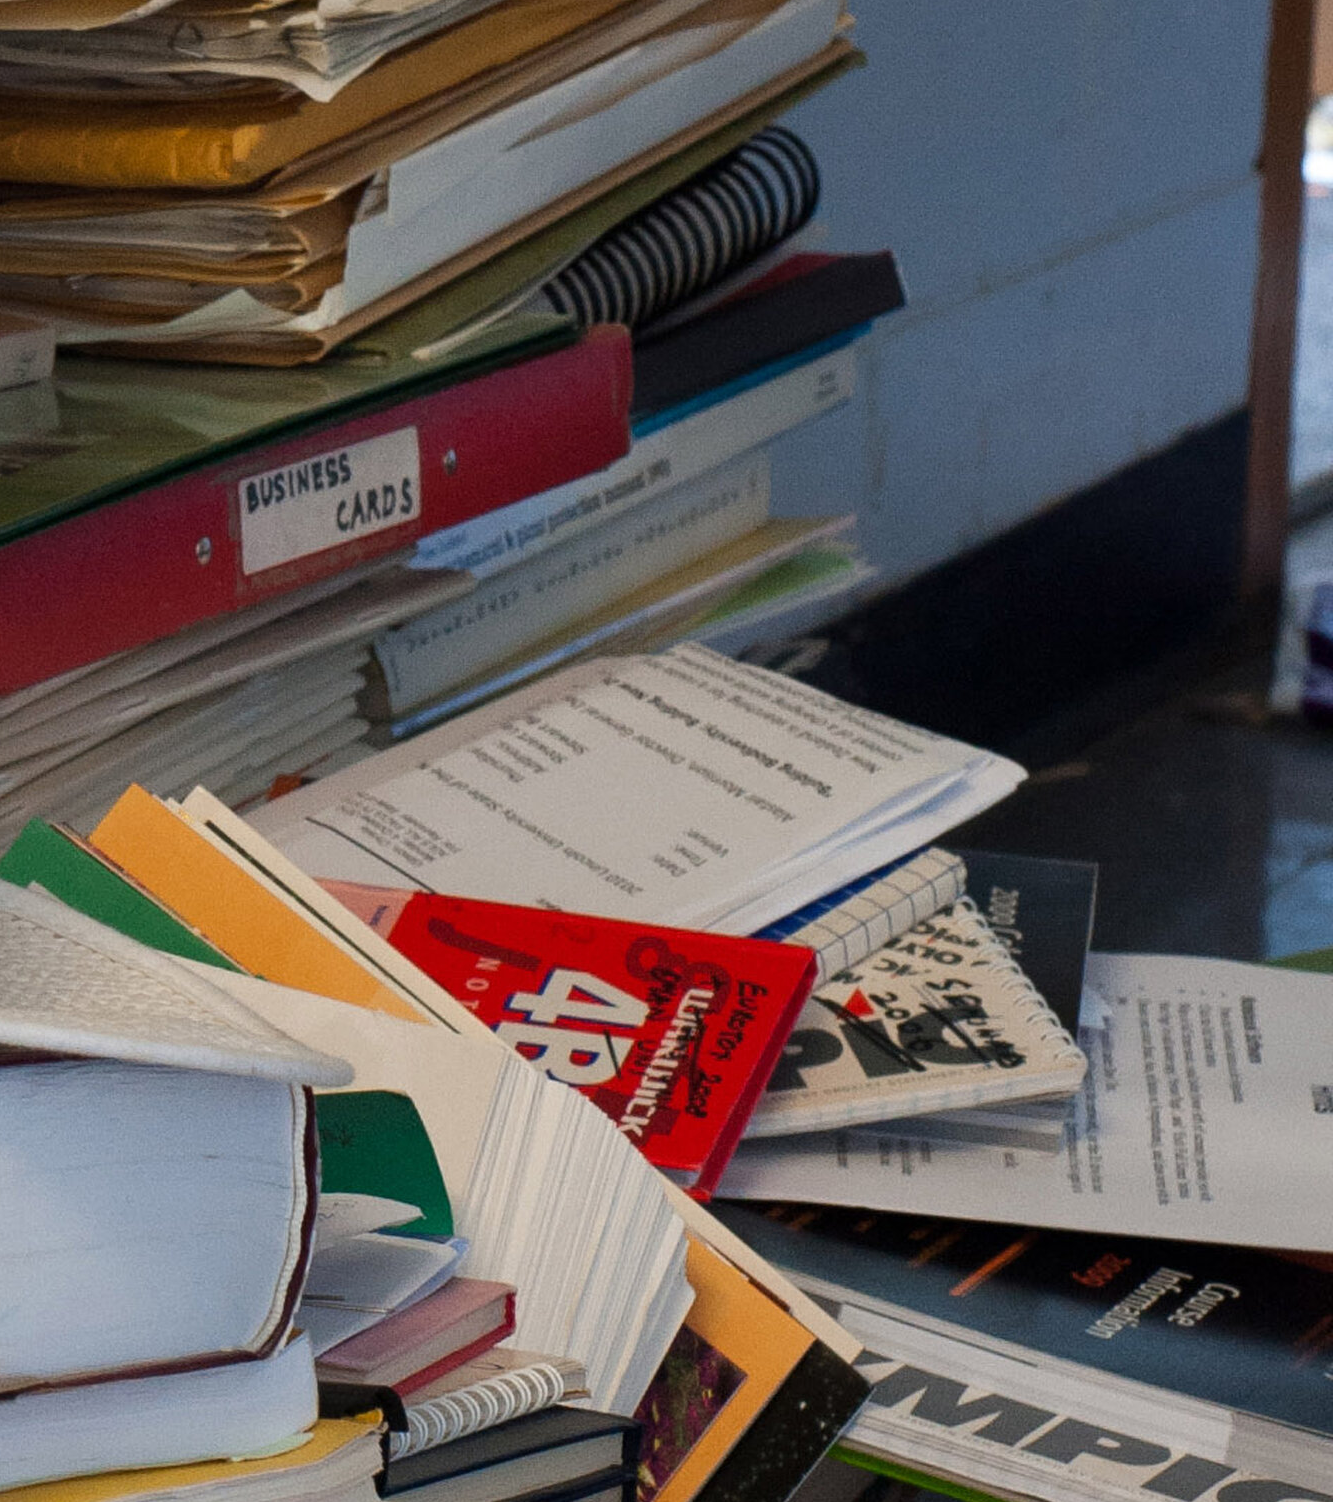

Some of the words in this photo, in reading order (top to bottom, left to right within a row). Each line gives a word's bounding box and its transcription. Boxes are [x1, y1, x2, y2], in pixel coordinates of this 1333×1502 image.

[245, 451, 353, 515] BUSINESS
[336, 476, 414, 533] CARDS
[1084, 1266, 1194, 1340] Information
[1167, 1281, 1241, 1329] Course
